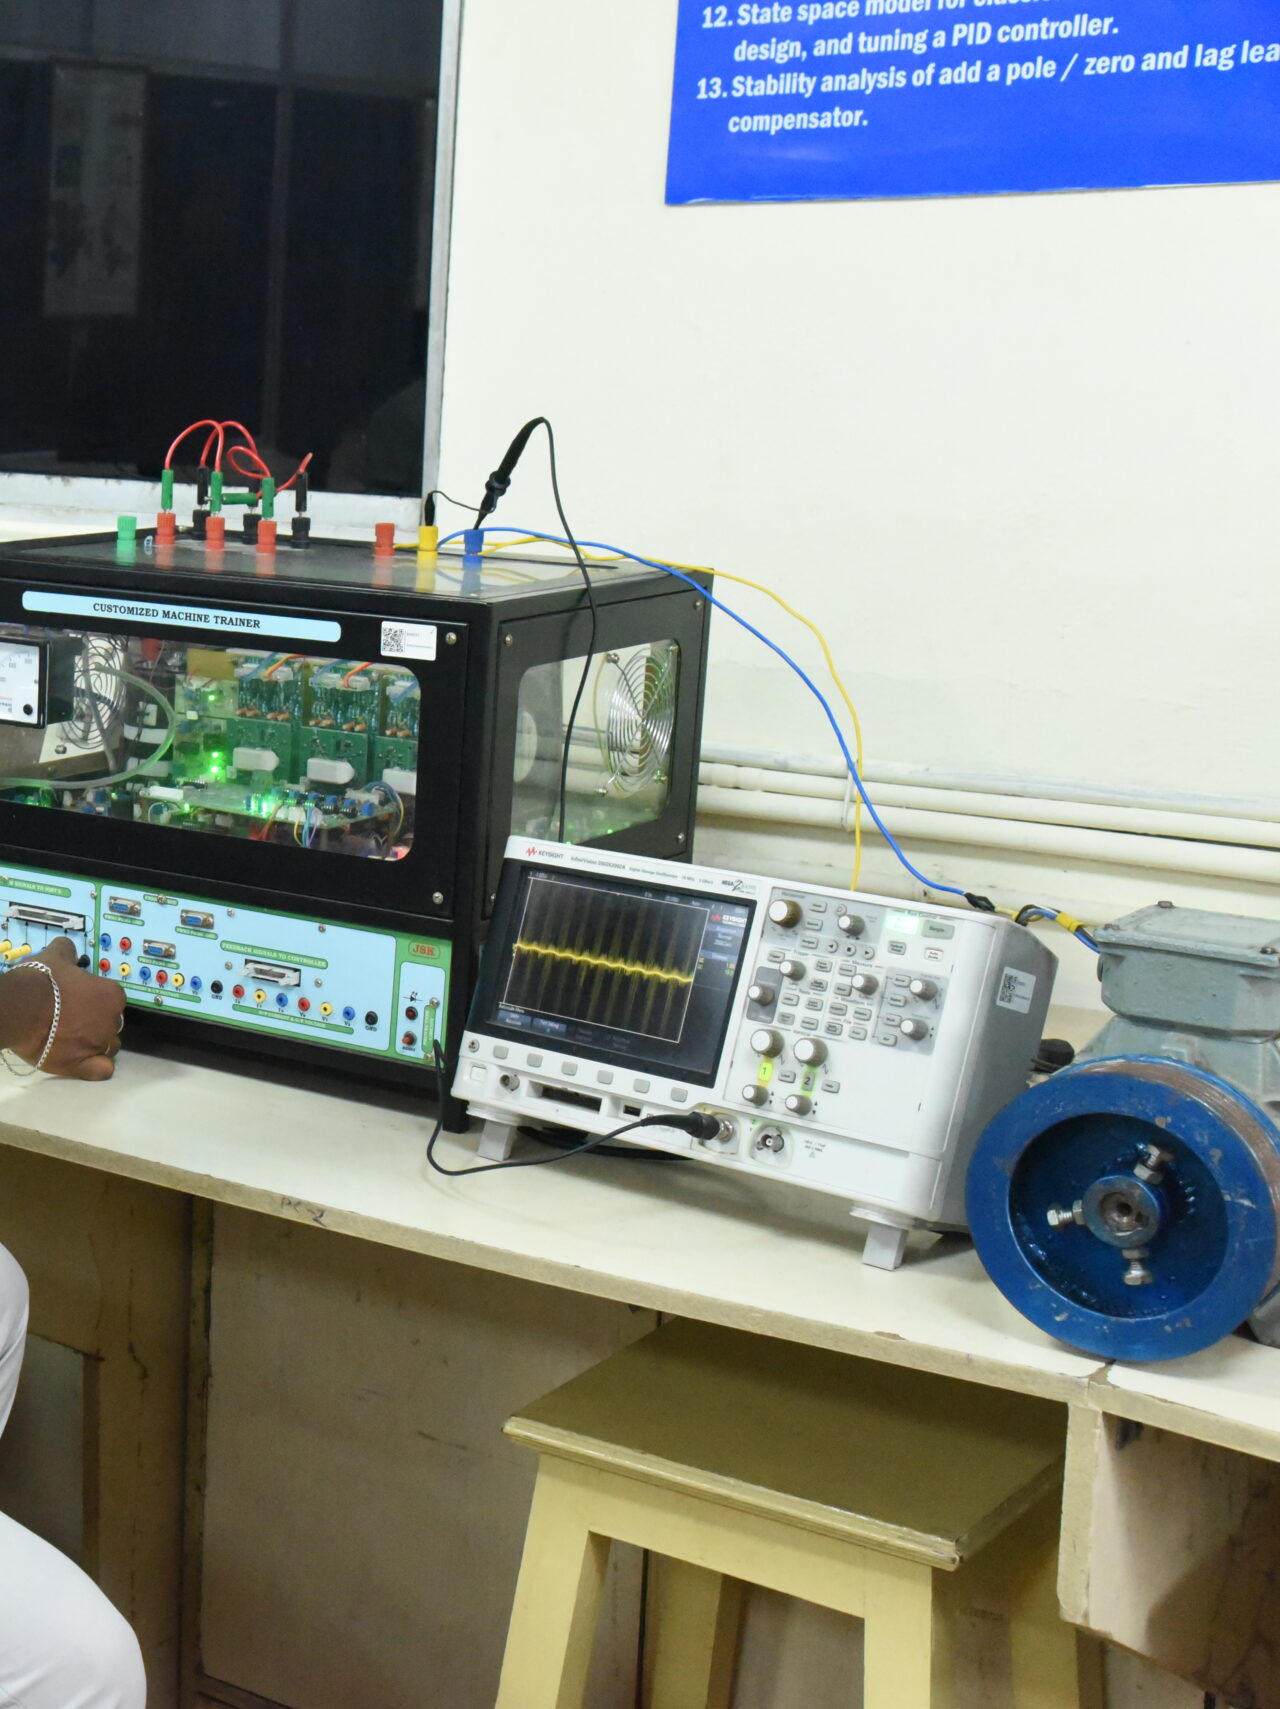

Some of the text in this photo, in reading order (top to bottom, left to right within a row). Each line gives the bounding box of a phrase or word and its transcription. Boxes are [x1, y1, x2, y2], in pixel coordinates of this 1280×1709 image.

[702, 6, 733, 28] 12.
[737, 2, 792, 26] State
[797, 0, 860, 25] space
[734, 14, 1119, 63] design, and tuning a PID controller.
[697, 77, 727, 99] 13.
[732, 72, 816, 98] Stability
[820, 66, 907, 95] analysis
[912, 62, 935, 87] of
[939, 60, 981, 85] add
[986, 64, 1000, 82] a
[1006, 56, 1057, 86] pole
[1060, 53, 1079, 82] /
[1084, 54, 1135, 76] zero
[1141, 45, 1189, 71] and
[1194, 43, 1237, 71] lag
[728, 106, 868, 135] compensator.
[93, 603, 261, 629] CUSTOMIZED MACHINE TRAINER
[538, 850, 564, 860] KEYSIGHT
[288, 955, 327, 967] CONTROLLER
[804, 1076, 811, 1086] 2
